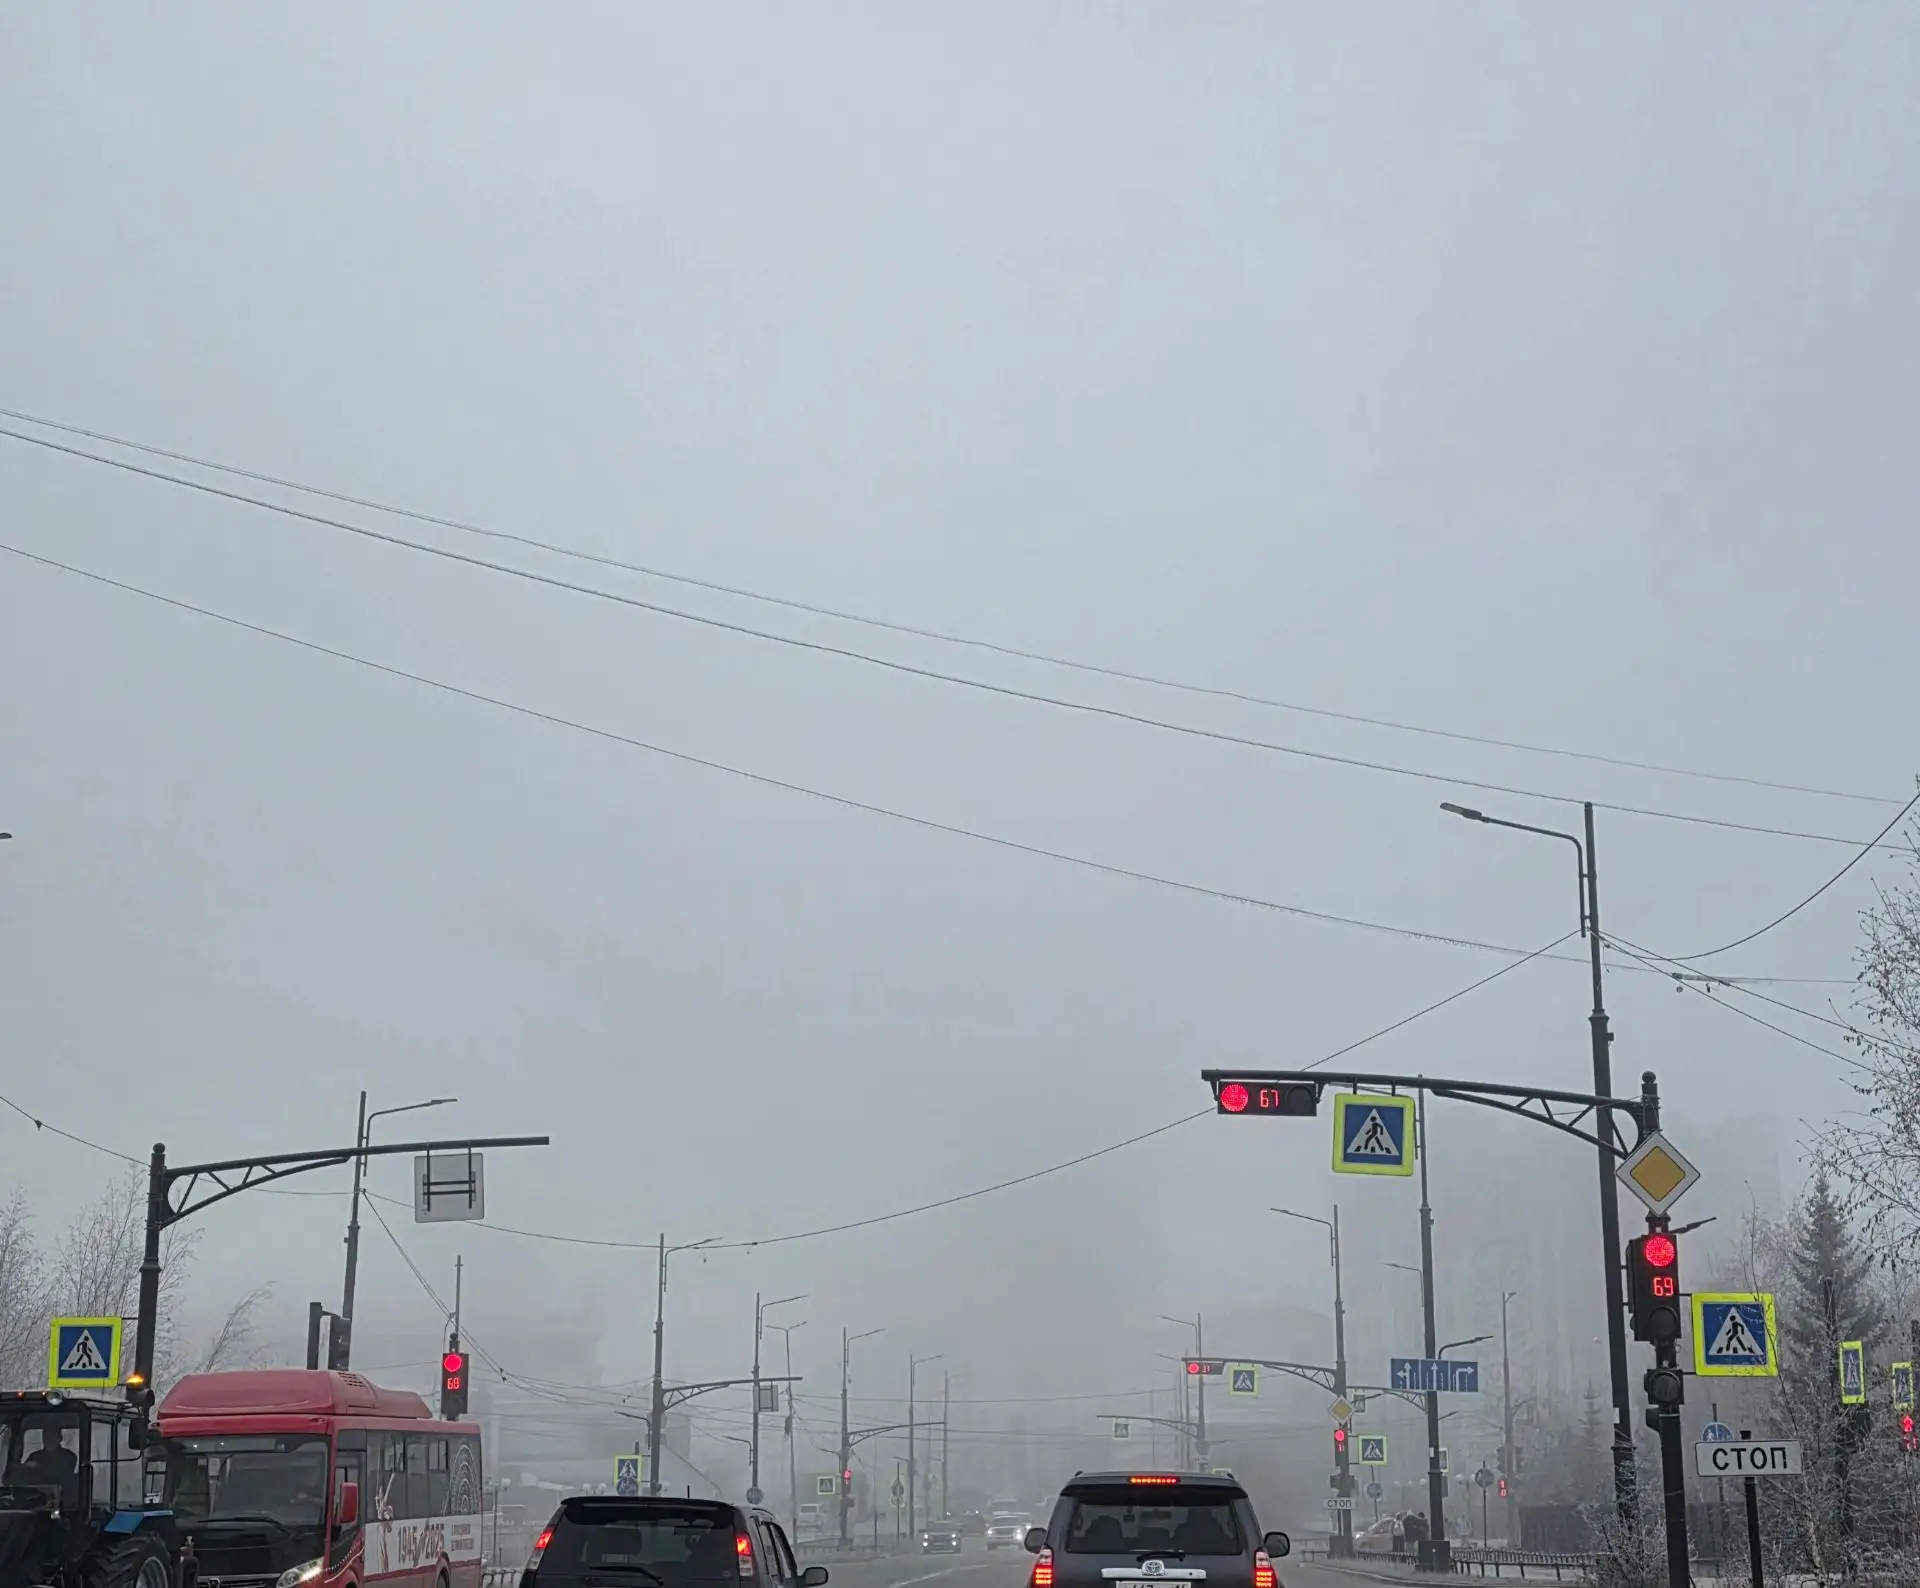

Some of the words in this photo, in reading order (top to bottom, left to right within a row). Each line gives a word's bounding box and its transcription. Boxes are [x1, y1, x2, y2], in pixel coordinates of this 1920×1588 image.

[1260, 1089, 1279, 1108] 67
[1653, 1277, 1674, 1297] 69
[1712, 1447, 1788, 1471] СТОП
[1327, 1499, 1352, 1508] СТОП
